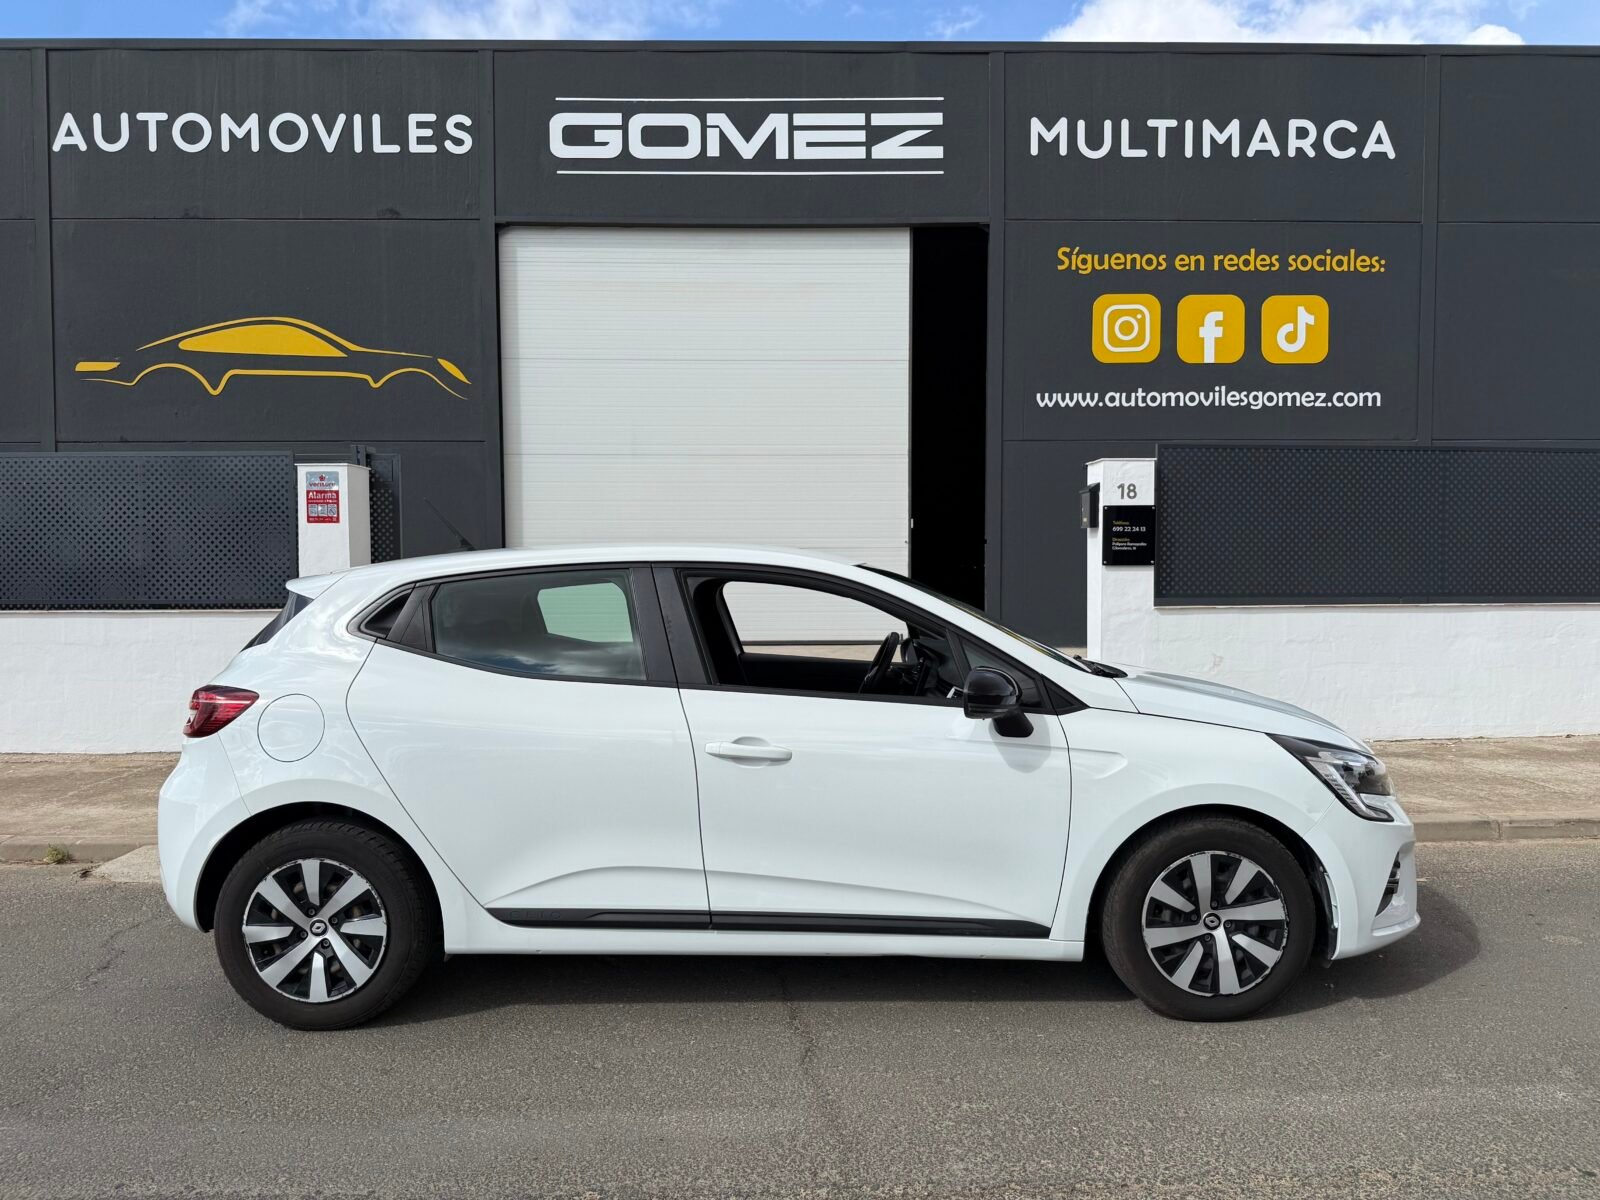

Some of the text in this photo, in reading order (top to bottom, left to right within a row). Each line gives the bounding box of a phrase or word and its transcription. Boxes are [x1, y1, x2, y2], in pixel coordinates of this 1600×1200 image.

[52, 112, 473, 155] AUTOMOVILES
[549, 112, 943, 160] GOMEZ
[1030, 117, 1396, 160] MULTIMARCA
[1057, 246, 1386, 275] Síguenos en redes sociales:
[1036, 385, 1382, 410] www.automovilesgomez.com
[1117, 483, 1138, 500] 18
